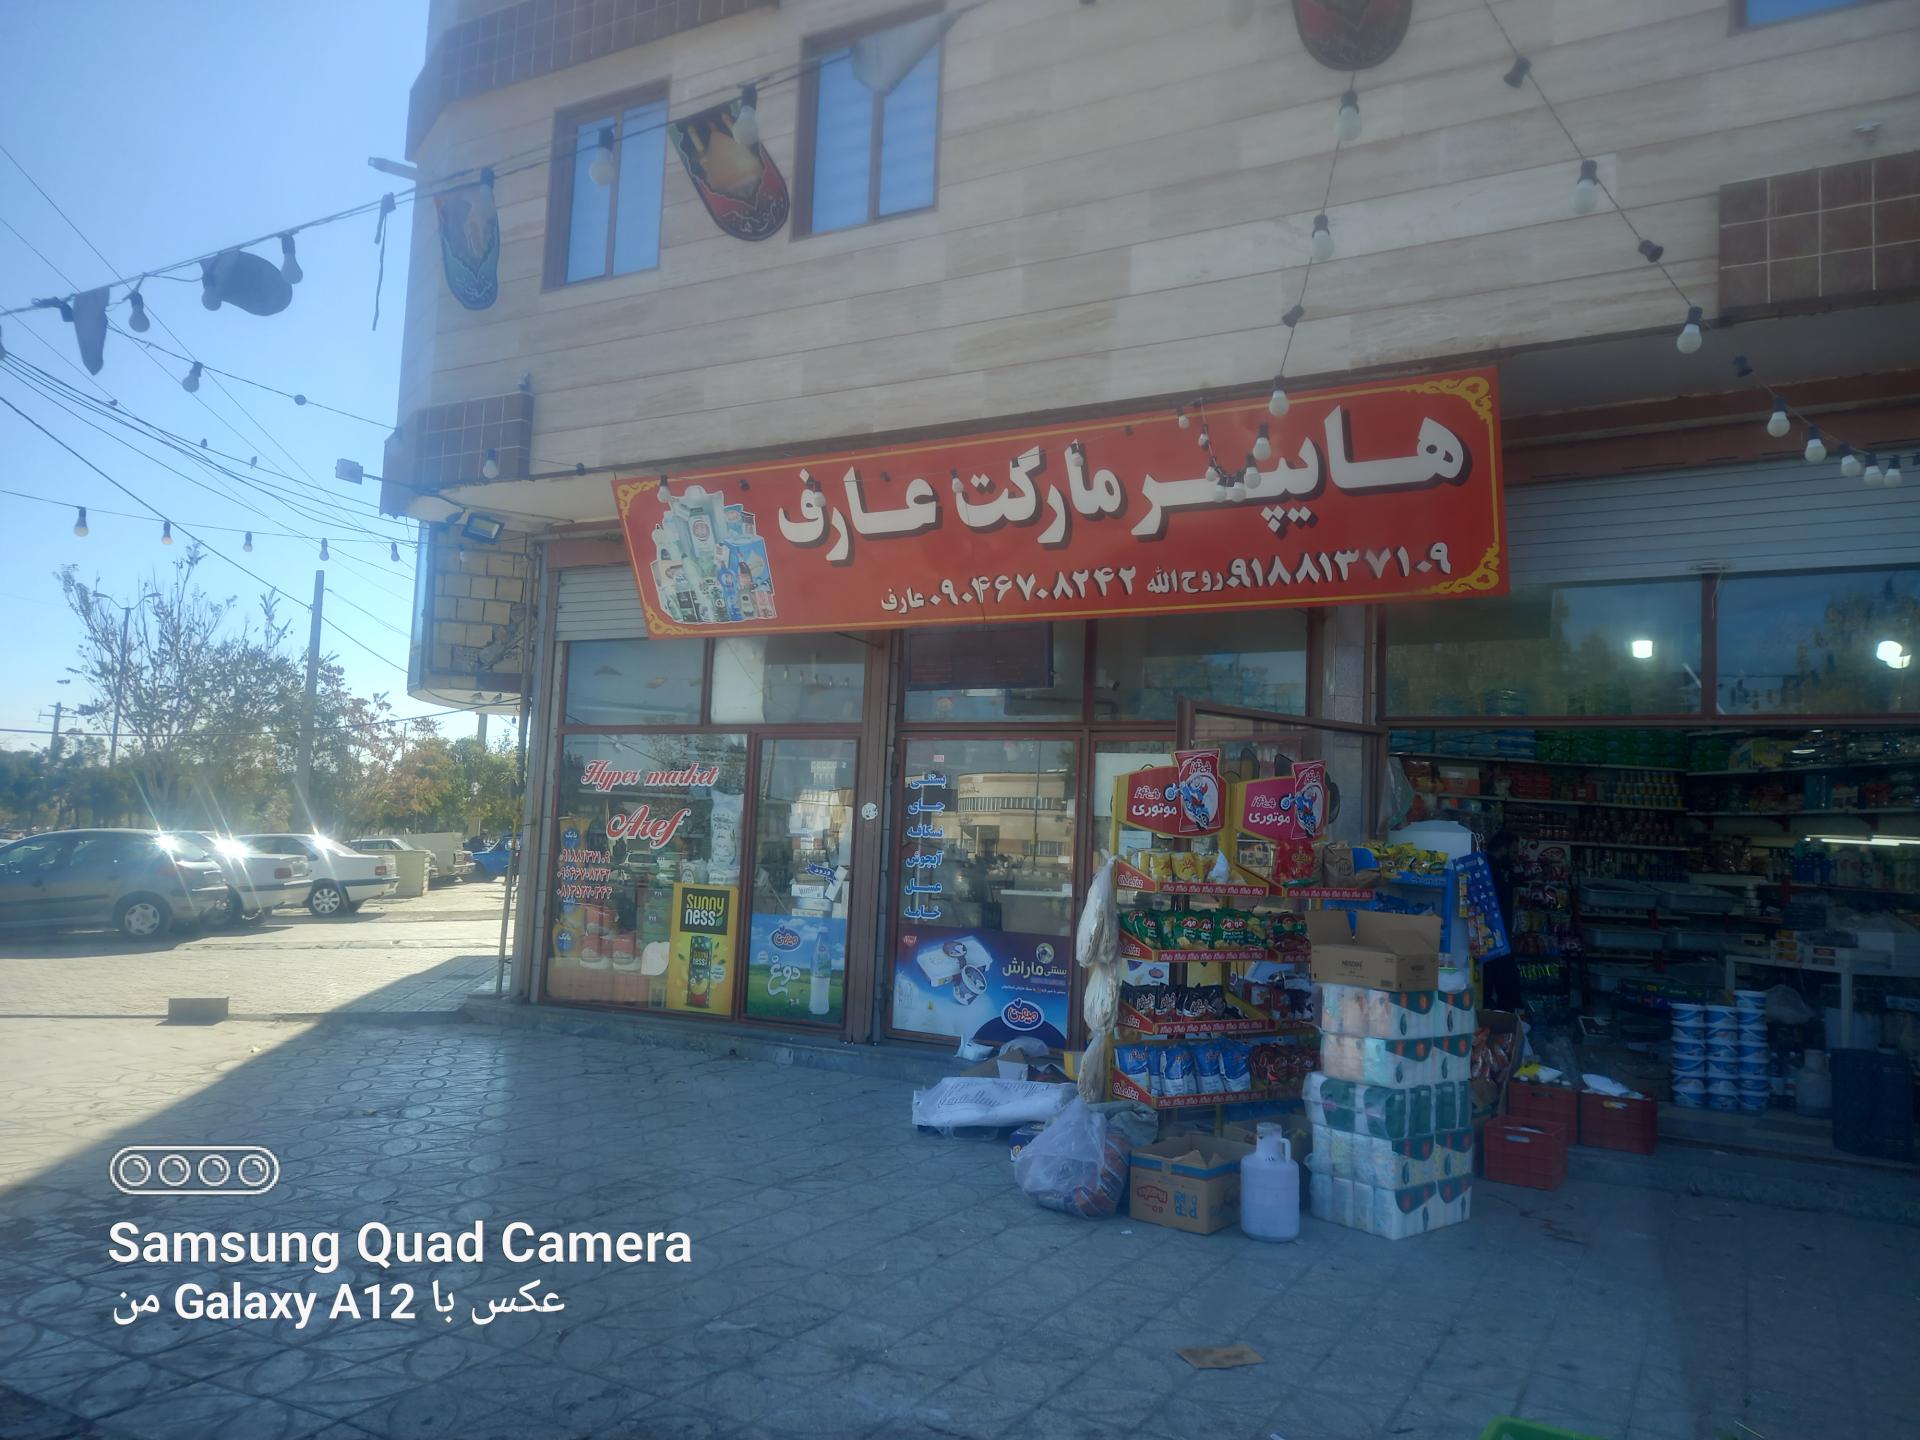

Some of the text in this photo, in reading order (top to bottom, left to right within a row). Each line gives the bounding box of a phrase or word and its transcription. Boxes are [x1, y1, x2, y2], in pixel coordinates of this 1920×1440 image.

[778, 405, 1464, 561] هایپر مارکت عارف
[880, 587, 925, 614] عارف
[581, 760, 720, 793] Hyper market
[910, 774, 947, 790] بستنی
[1132, 803, 1177, 818] موتوری
[1248, 812, 1291, 826] موتوری
[606, 804, 692, 850] Aref
[906, 823, 945, 839] نسکافه
[905, 850, 945, 869] آبجوش
[904, 877, 943, 896] عسل
[686, 893, 725, 918] sunny
[904, 904, 942, 920] خامه
[685, 908, 716, 927] ness
[768, 956, 801, 997] دوغ
[1002, 957, 1044, 979] ماراش
